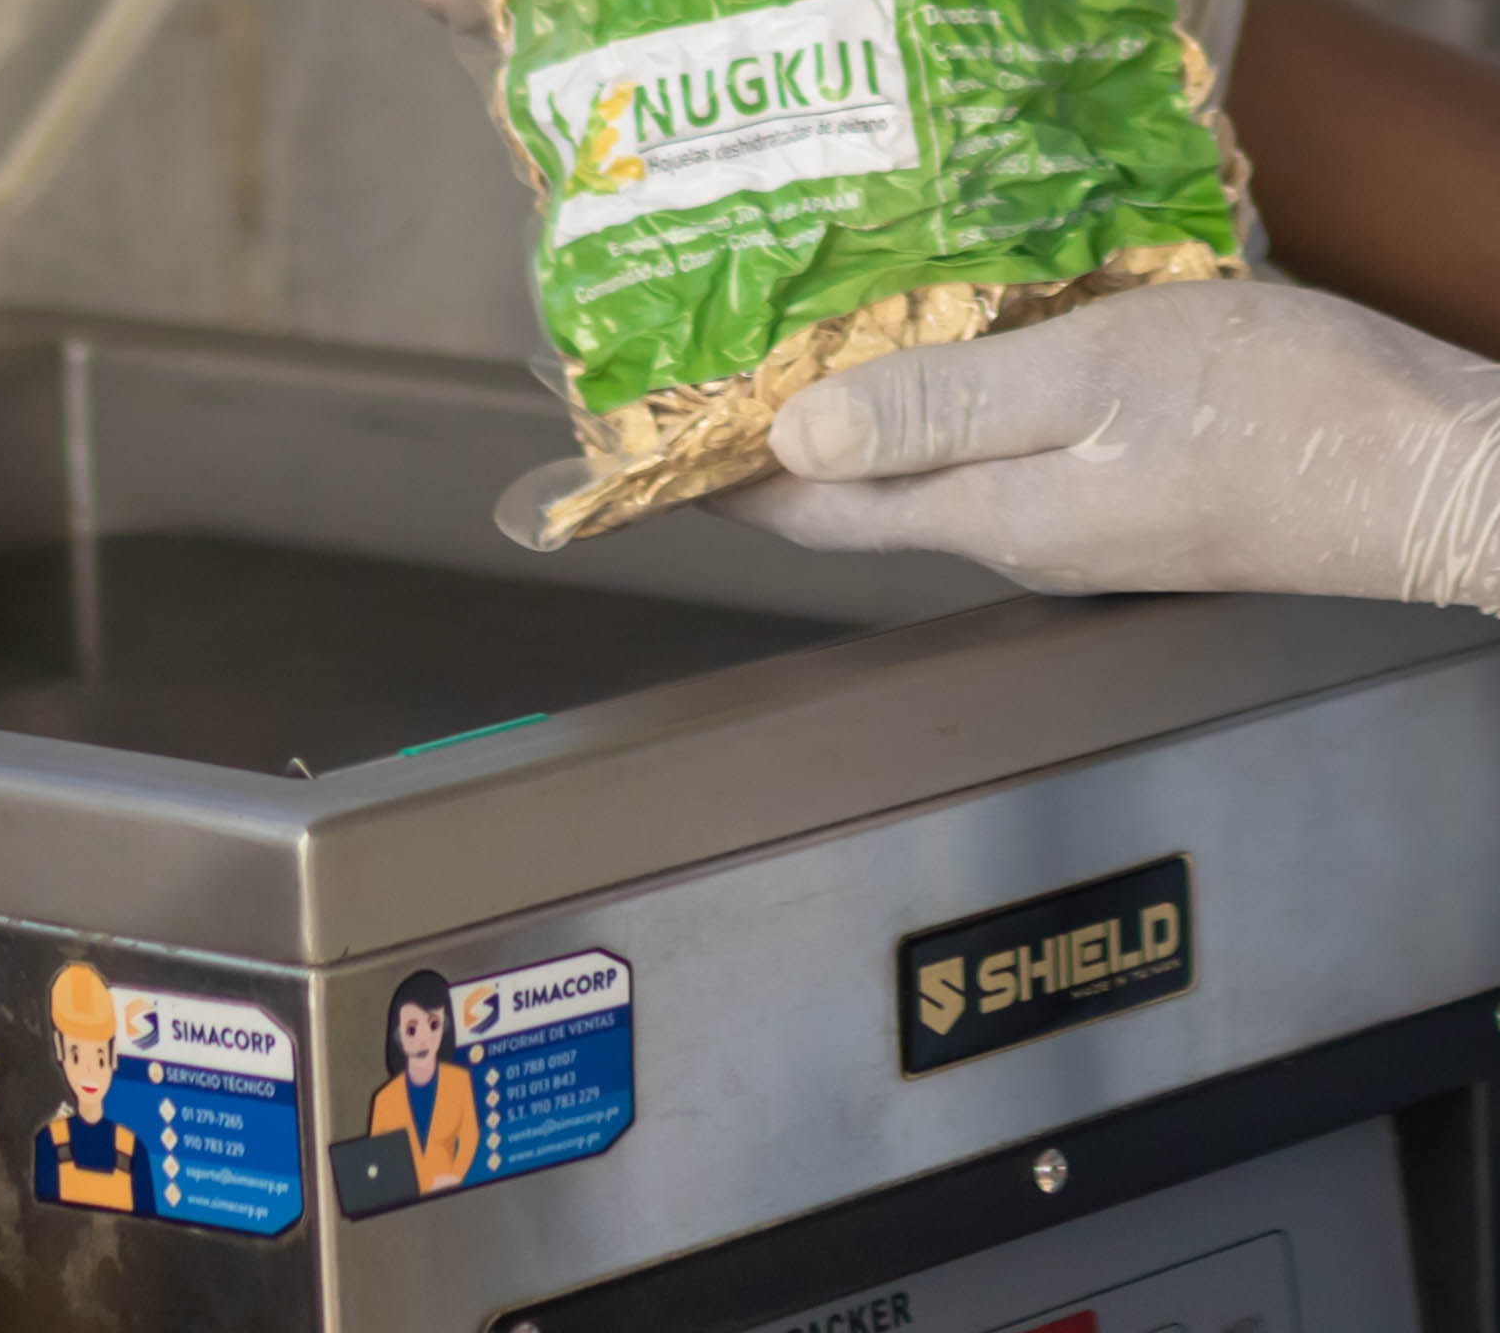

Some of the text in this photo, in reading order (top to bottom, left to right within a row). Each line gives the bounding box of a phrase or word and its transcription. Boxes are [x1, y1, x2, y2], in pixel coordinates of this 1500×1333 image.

[634, 39, 881, 143] NUGKUI
[978, 902, 1179, 1014] SHIELD
[513, 968, 617, 1012] SIMACORP
[172, 1020, 276, 1054] SIMACORP
[488, 1012, 615, 1056] INFORME DE VENTAS
[166, 1067, 220, 1090] SERVICIO
[506, 1064, 519, 1079] 01
[182, 1106, 193, 1121] 01
